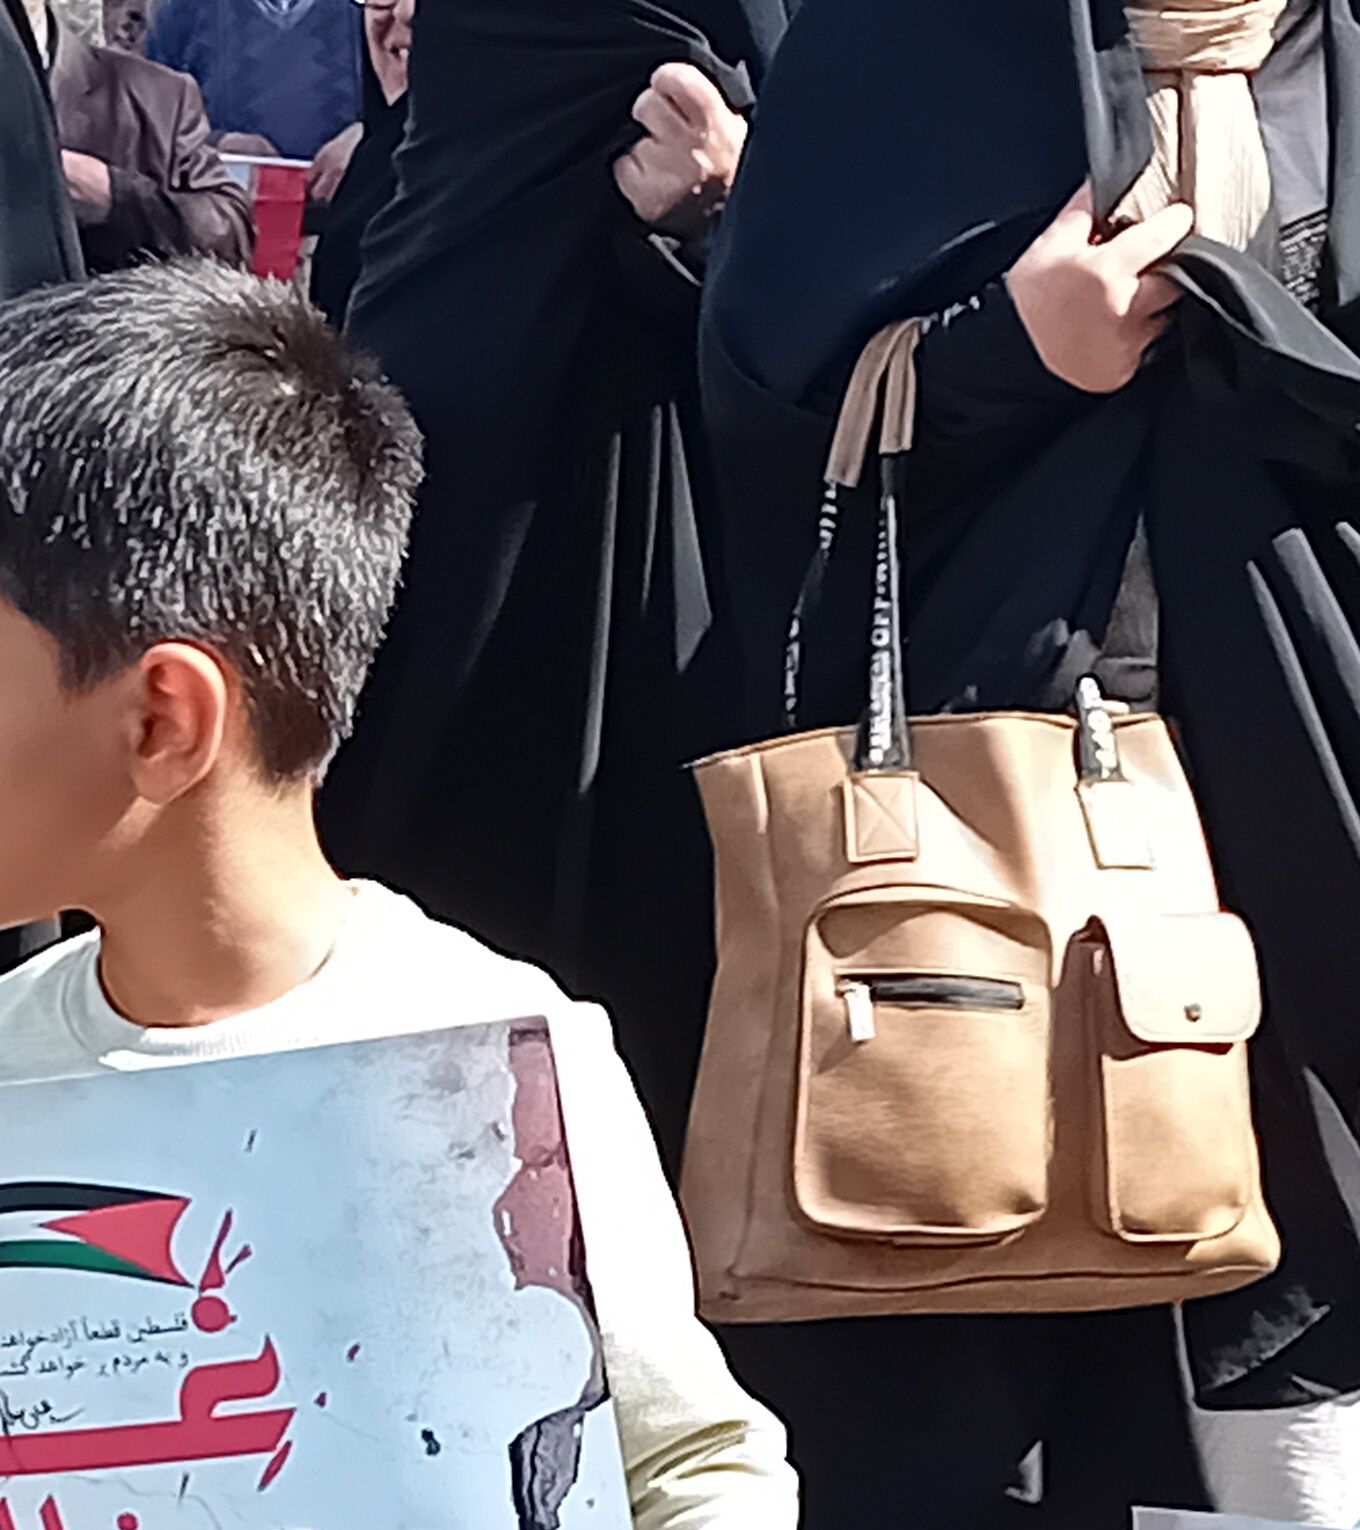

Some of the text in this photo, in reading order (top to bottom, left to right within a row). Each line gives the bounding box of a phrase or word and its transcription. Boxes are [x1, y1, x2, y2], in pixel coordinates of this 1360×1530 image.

[126, 1311, 189, 1344] فلسطین
[112, 1355, 149, 1375] مردم
[178, 1351, 189, 1369] و
